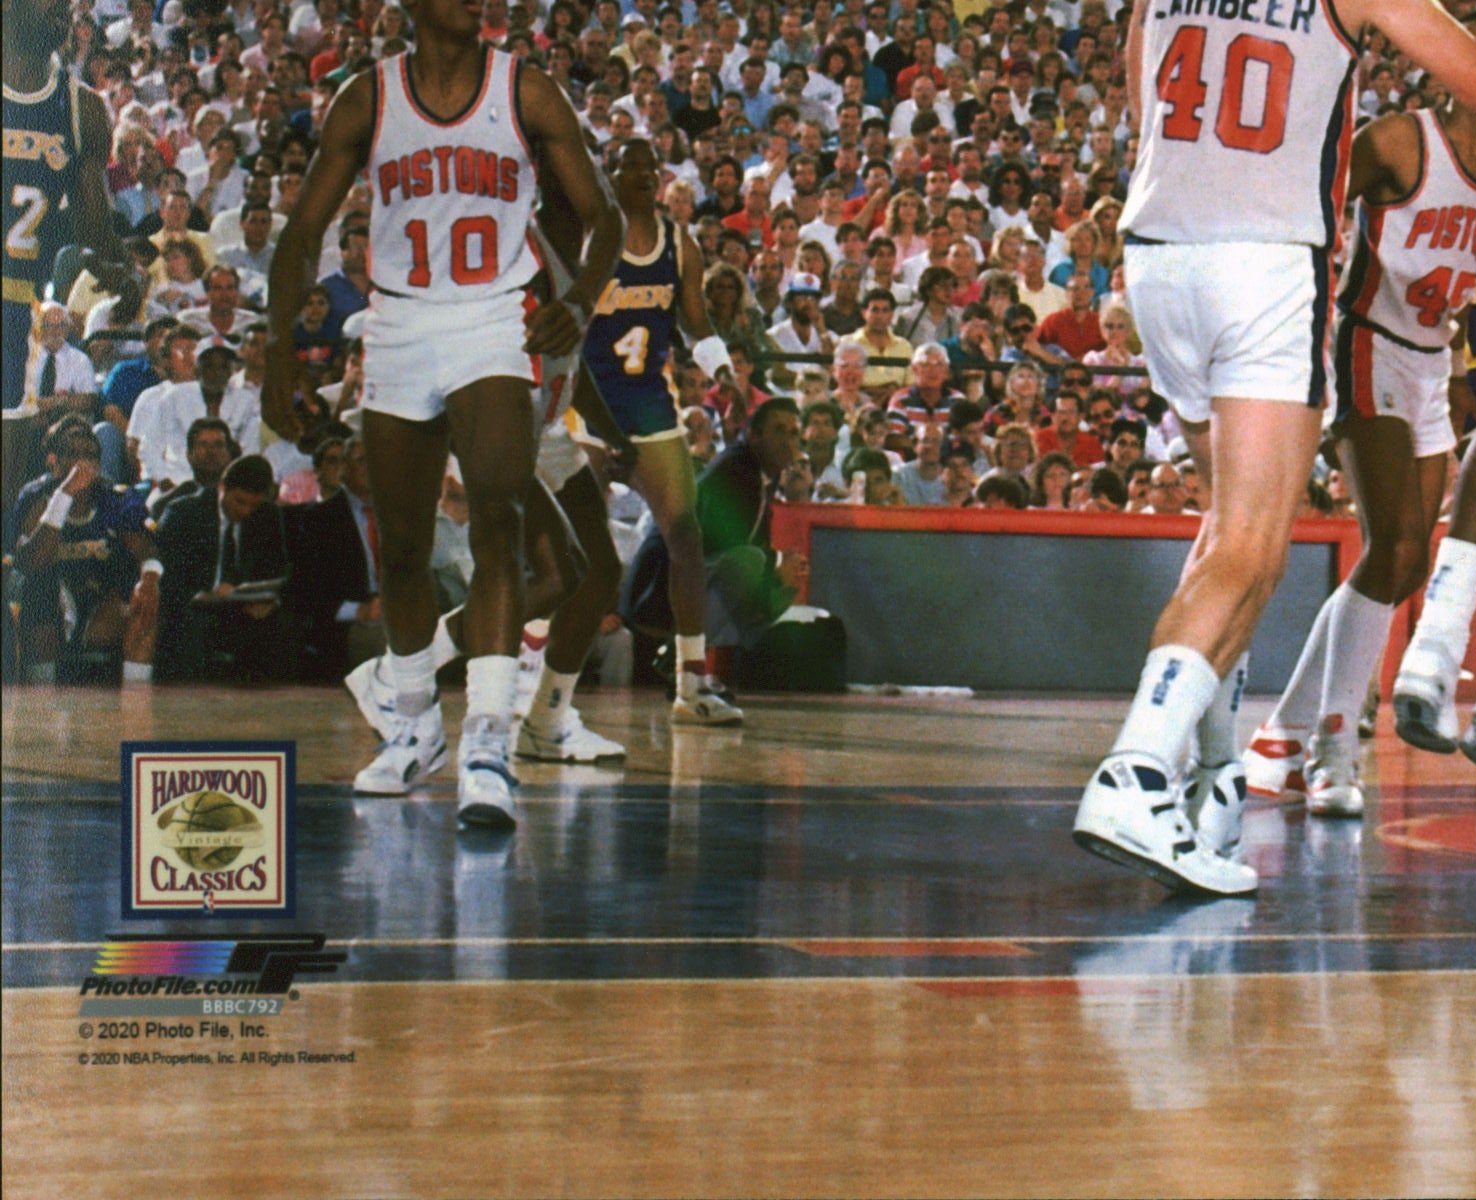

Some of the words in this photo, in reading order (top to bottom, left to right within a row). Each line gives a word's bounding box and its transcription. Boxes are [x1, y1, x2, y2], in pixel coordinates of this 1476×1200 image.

[1156, 24, 1295, 155] 40
[378, 145, 520, 207] PISTONS
[405, 215, 498, 288] 10
[613, 325, 650, 376] 4
